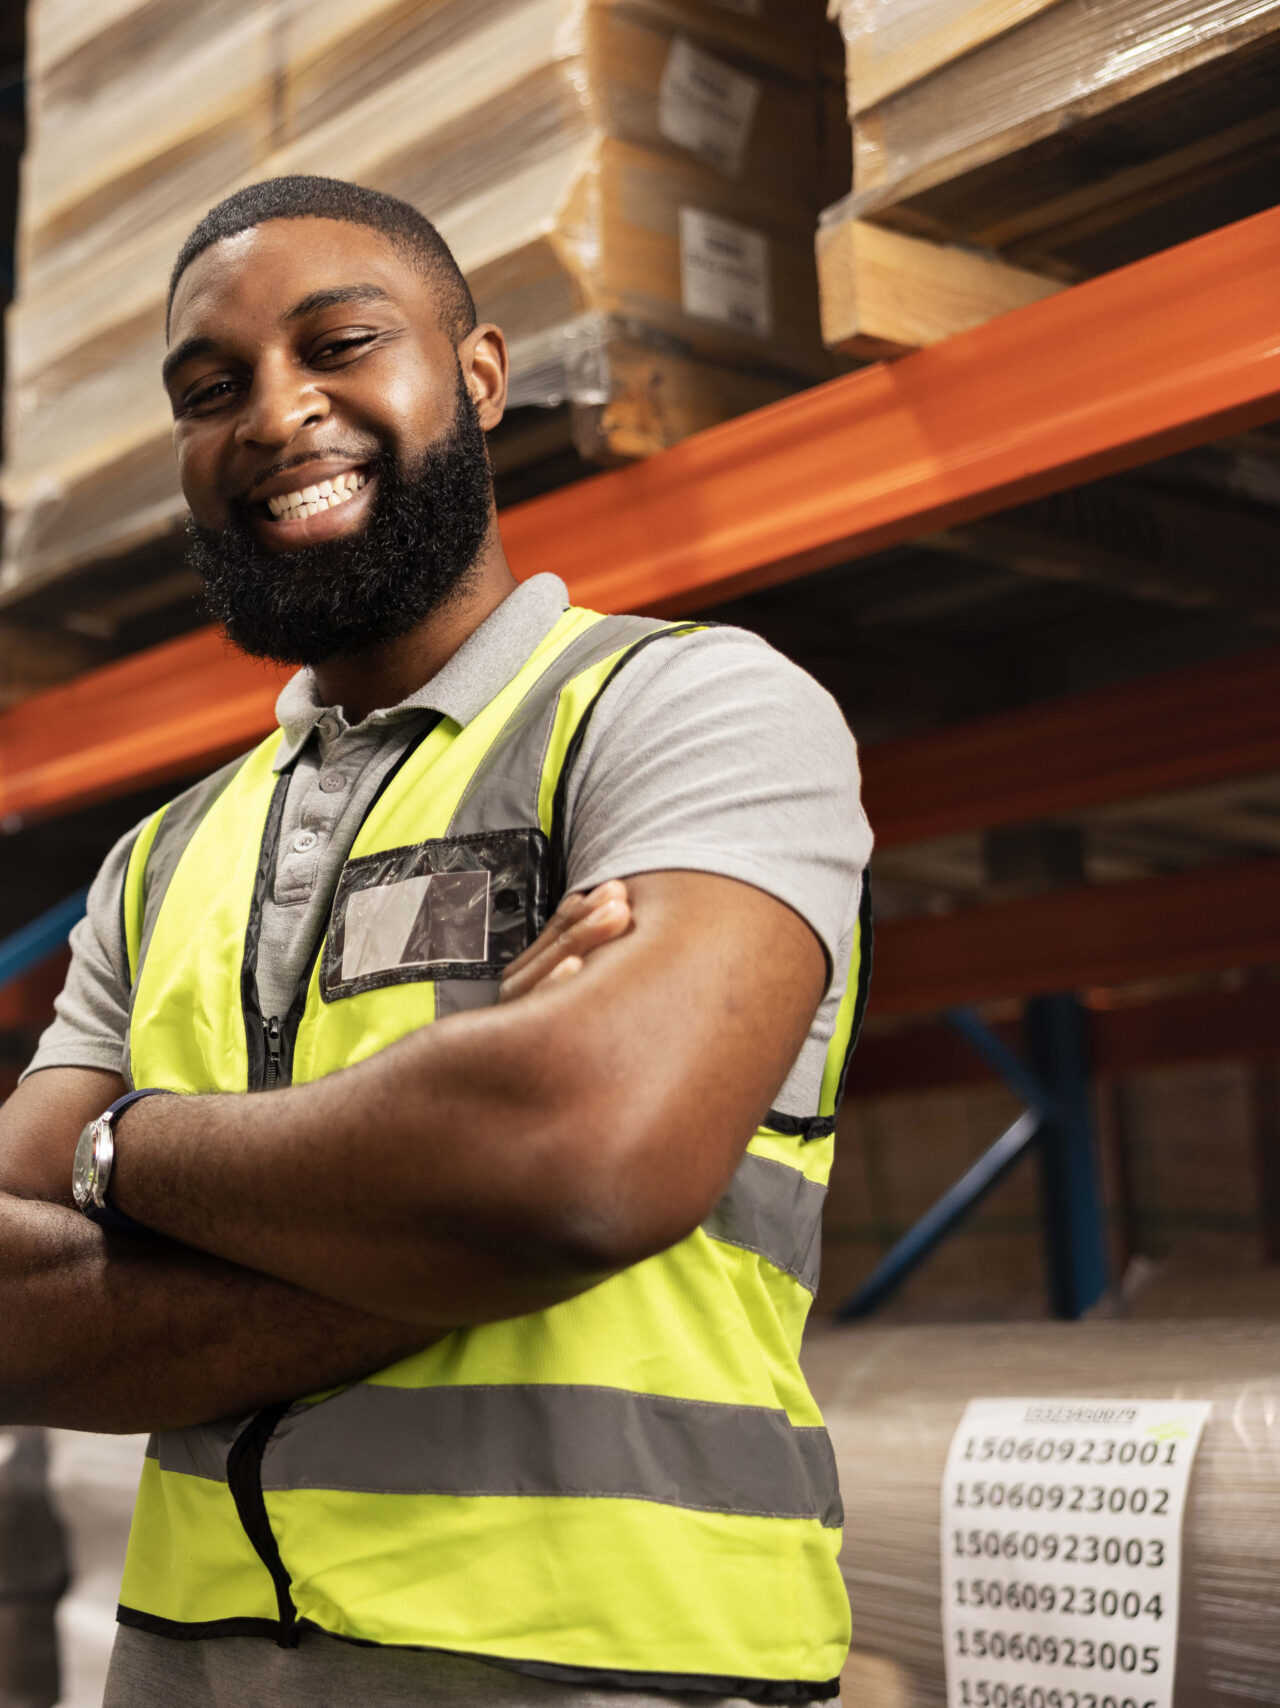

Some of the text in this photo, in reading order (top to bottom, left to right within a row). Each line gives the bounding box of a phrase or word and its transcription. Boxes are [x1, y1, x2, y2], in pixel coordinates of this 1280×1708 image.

[964, 1437, 1177, 1466] 15060923001
[954, 1481, 1170, 1516] 15060923002
[952, 1529, 1166, 1568] 15060923003
[954, 1578, 1165, 1622] 15060923004
[955, 1628, 1160, 1676] 15060923005
